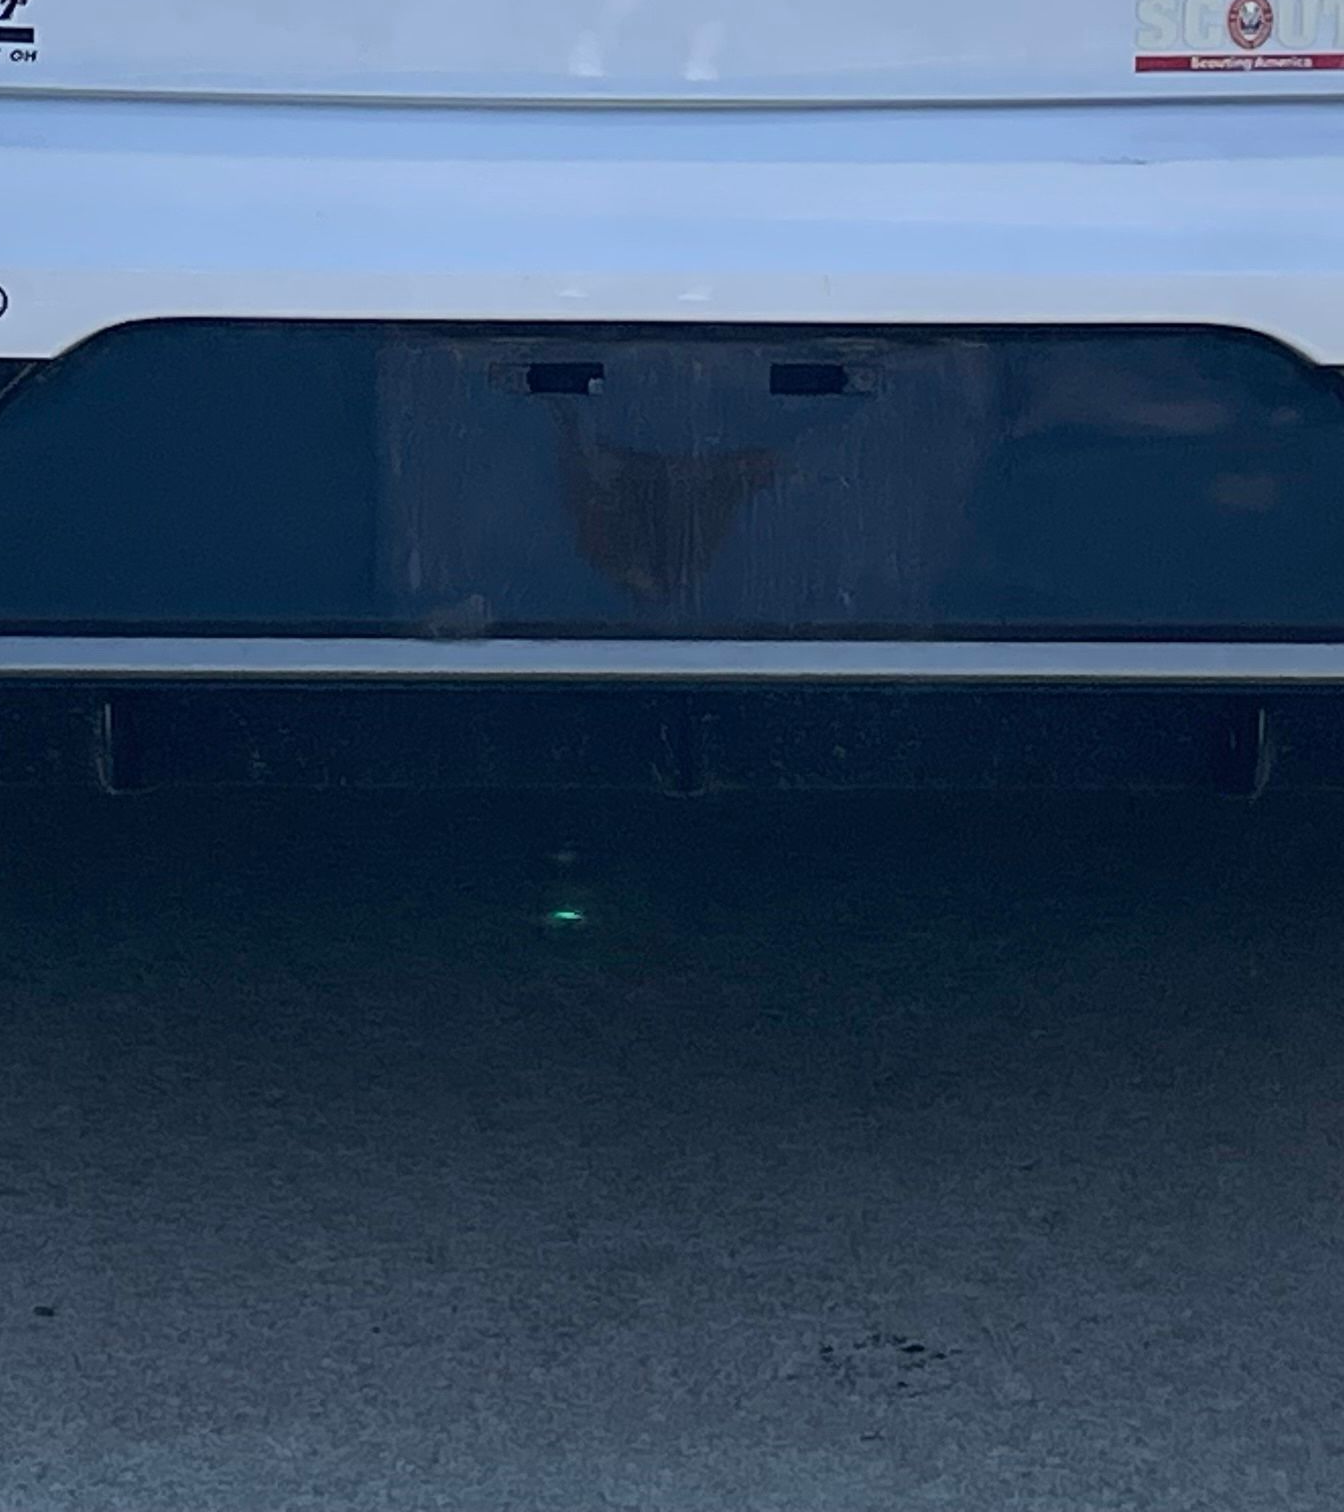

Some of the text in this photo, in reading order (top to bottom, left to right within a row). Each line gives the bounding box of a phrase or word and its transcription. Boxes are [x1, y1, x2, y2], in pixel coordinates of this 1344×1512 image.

[10, 48, 38, 63] OH
[1191, 54, 1313, 71] Scouting America
